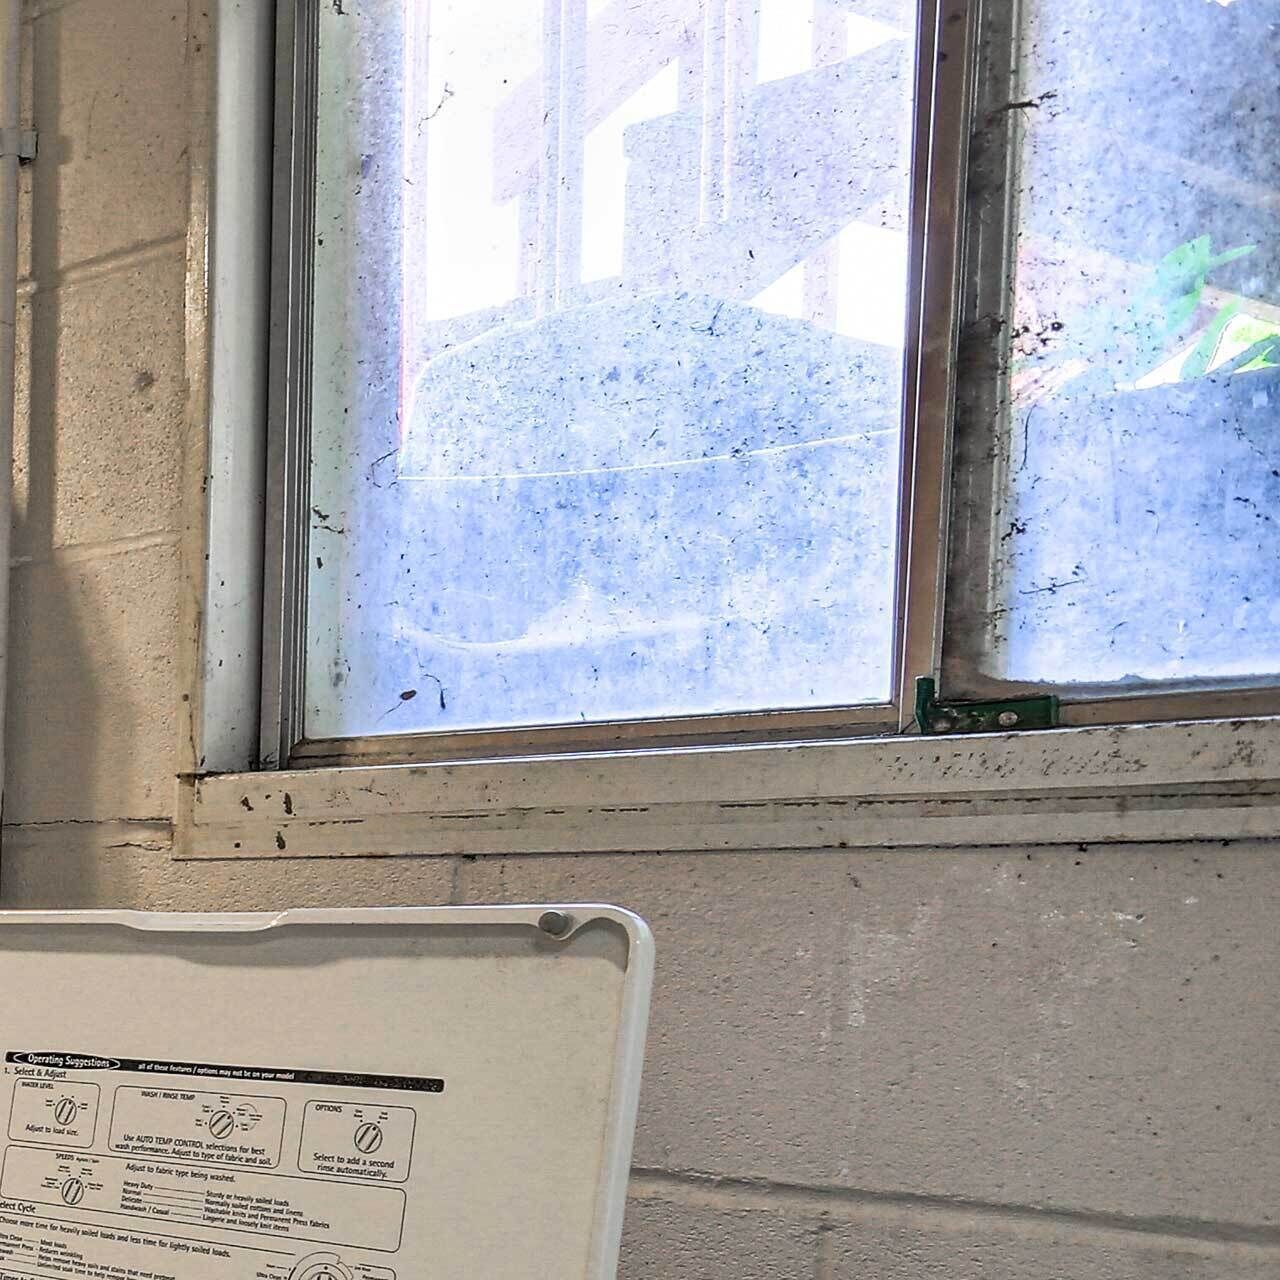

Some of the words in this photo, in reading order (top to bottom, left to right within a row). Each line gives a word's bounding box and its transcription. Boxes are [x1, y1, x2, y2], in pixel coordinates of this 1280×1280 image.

[26, 1052, 64, 1067] Operating
[64, 1055, 111, 1071] Suggestions
[12, 1065, 35, 1077] Select
[42, 1067, 67, 1080] Adjust
[314, 1103, 343, 1113] OPTIONS
[24, 1122, 44, 1133] Adjust
[122, 1133, 135, 1142] Use
[134, 1134, 154, 1144] AUTO
[154, 1135, 173, 1145] TEMP
[172, 1138, 204, 1149] CONTROL
[205, 1141, 238, 1153] selections
[238, 1144, 250, 1154] for
[250, 1146, 265, 1156] best
[169, 1146, 192, 1157] Adjust
[200, 1150, 215, 1160] type
[223, 1152, 244, 1163] fabric
[243, 1155, 258, 1164] and
[312, 1151, 335, 1163] Select
[345, 1156, 361, 1165] add
[367, 1159, 395, 1169] second
[124, 1162, 146, 1173] Adjust
[154, 1165, 174, 1176] fabric
[174, 1168, 189, 1178] type
[189, 1169, 208, 1181] being
[316, 1162, 335, 1173] rinse
[16, 1201, 36, 1214] Cycle
[115, 1234, 129, 1242] and
[128, 1234, 141, 1244] less
[141, 1237, 157, 1247] time
